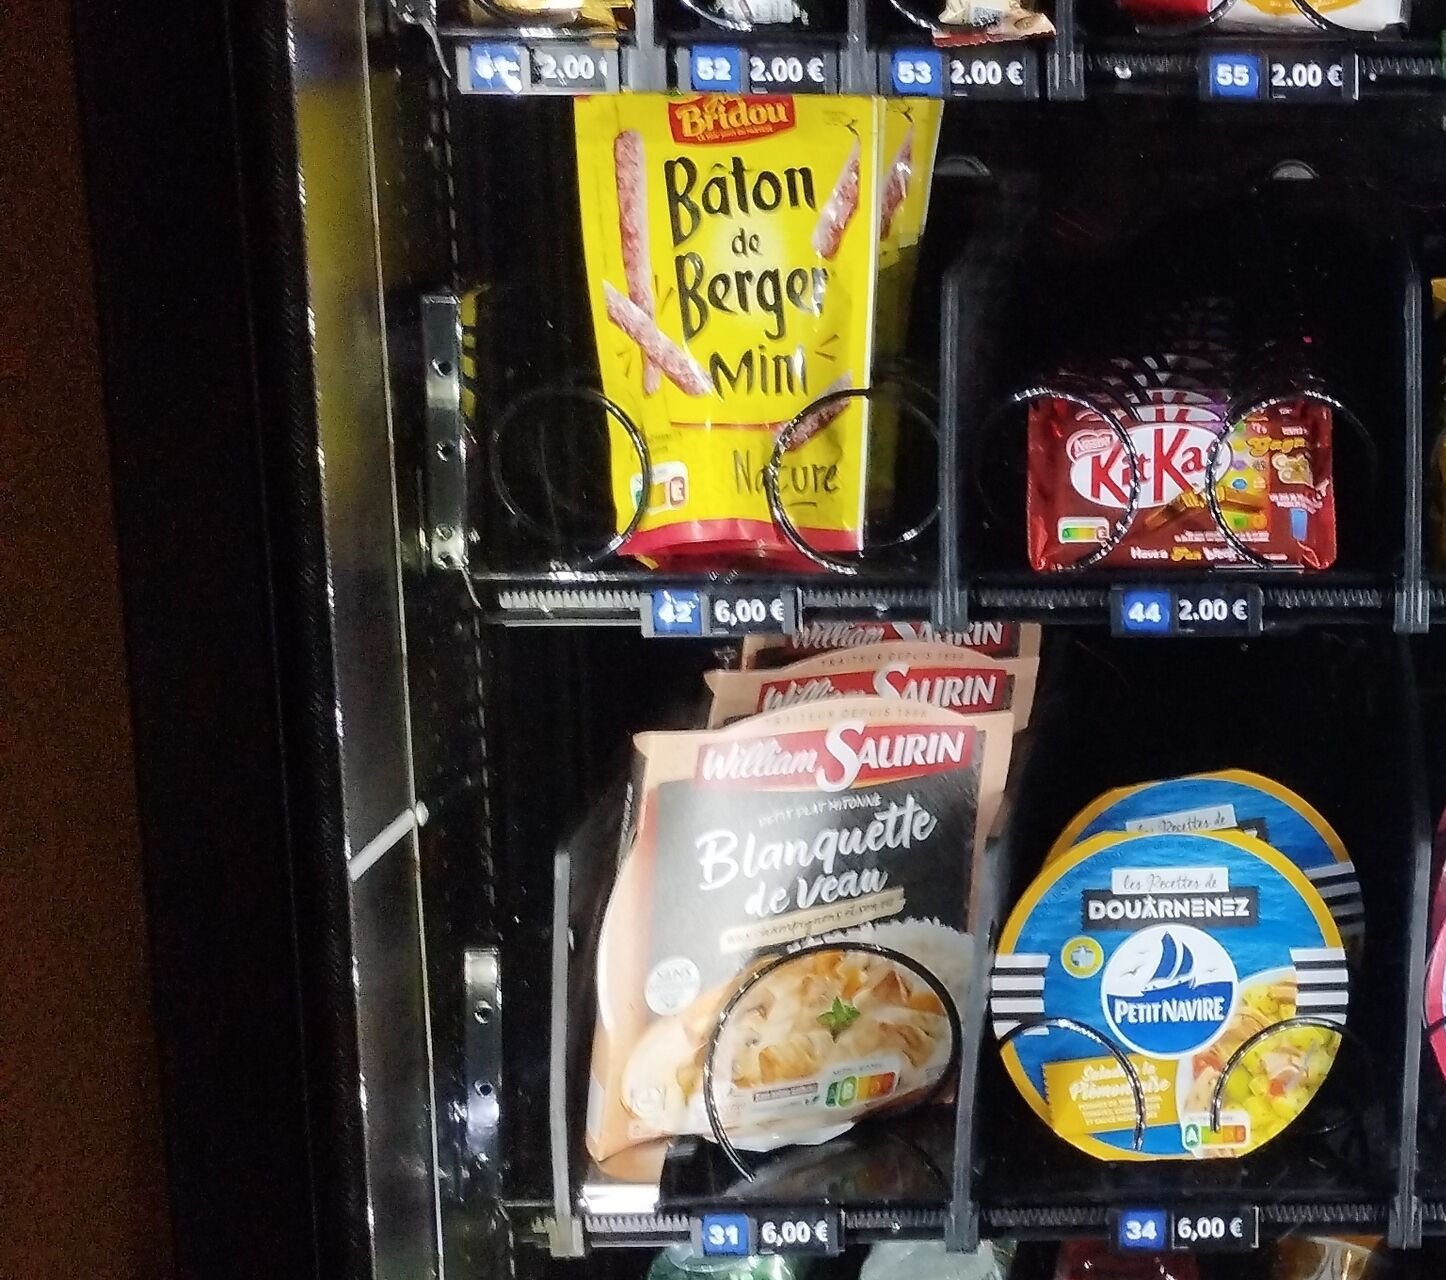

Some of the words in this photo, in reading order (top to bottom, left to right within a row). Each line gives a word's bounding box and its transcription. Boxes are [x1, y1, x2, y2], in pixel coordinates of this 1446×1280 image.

[696, 59, 732, 82] 52
[806, 59, 825, 83] €
[898, 61, 932, 83] 53
[1003, 61, 1023, 86] €
[1216, 65, 1249, 87] 55
[1327, 64, 1343, 87] €
[664, 155, 818, 248] Bâton
[730, 226, 761, 258] de
[673, 250, 831, 342] Berger
[768, 599, 785, 623] €
[1127, 601, 1162, 623] 44
[1231, 599, 1249, 622] €
[702, 739, 819, 781] William
[815, 721, 966, 792] SAURIN
[695, 792, 939, 891] Blanquette
[745, 881, 791, 918] de
[1112, 996, 1162, 1024] PETIT
[1162, 995, 1225, 1022] NAVIRE
[709, 1224, 740, 1246] 31
[762, 1222, 811, 1246] 6,00
[813, 1222, 829, 1244] €
[1124, 1219, 1157, 1240] 34
[1177, 1216, 1224, 1240] 6,00
[1229, 1218, 1243, 1239] €
